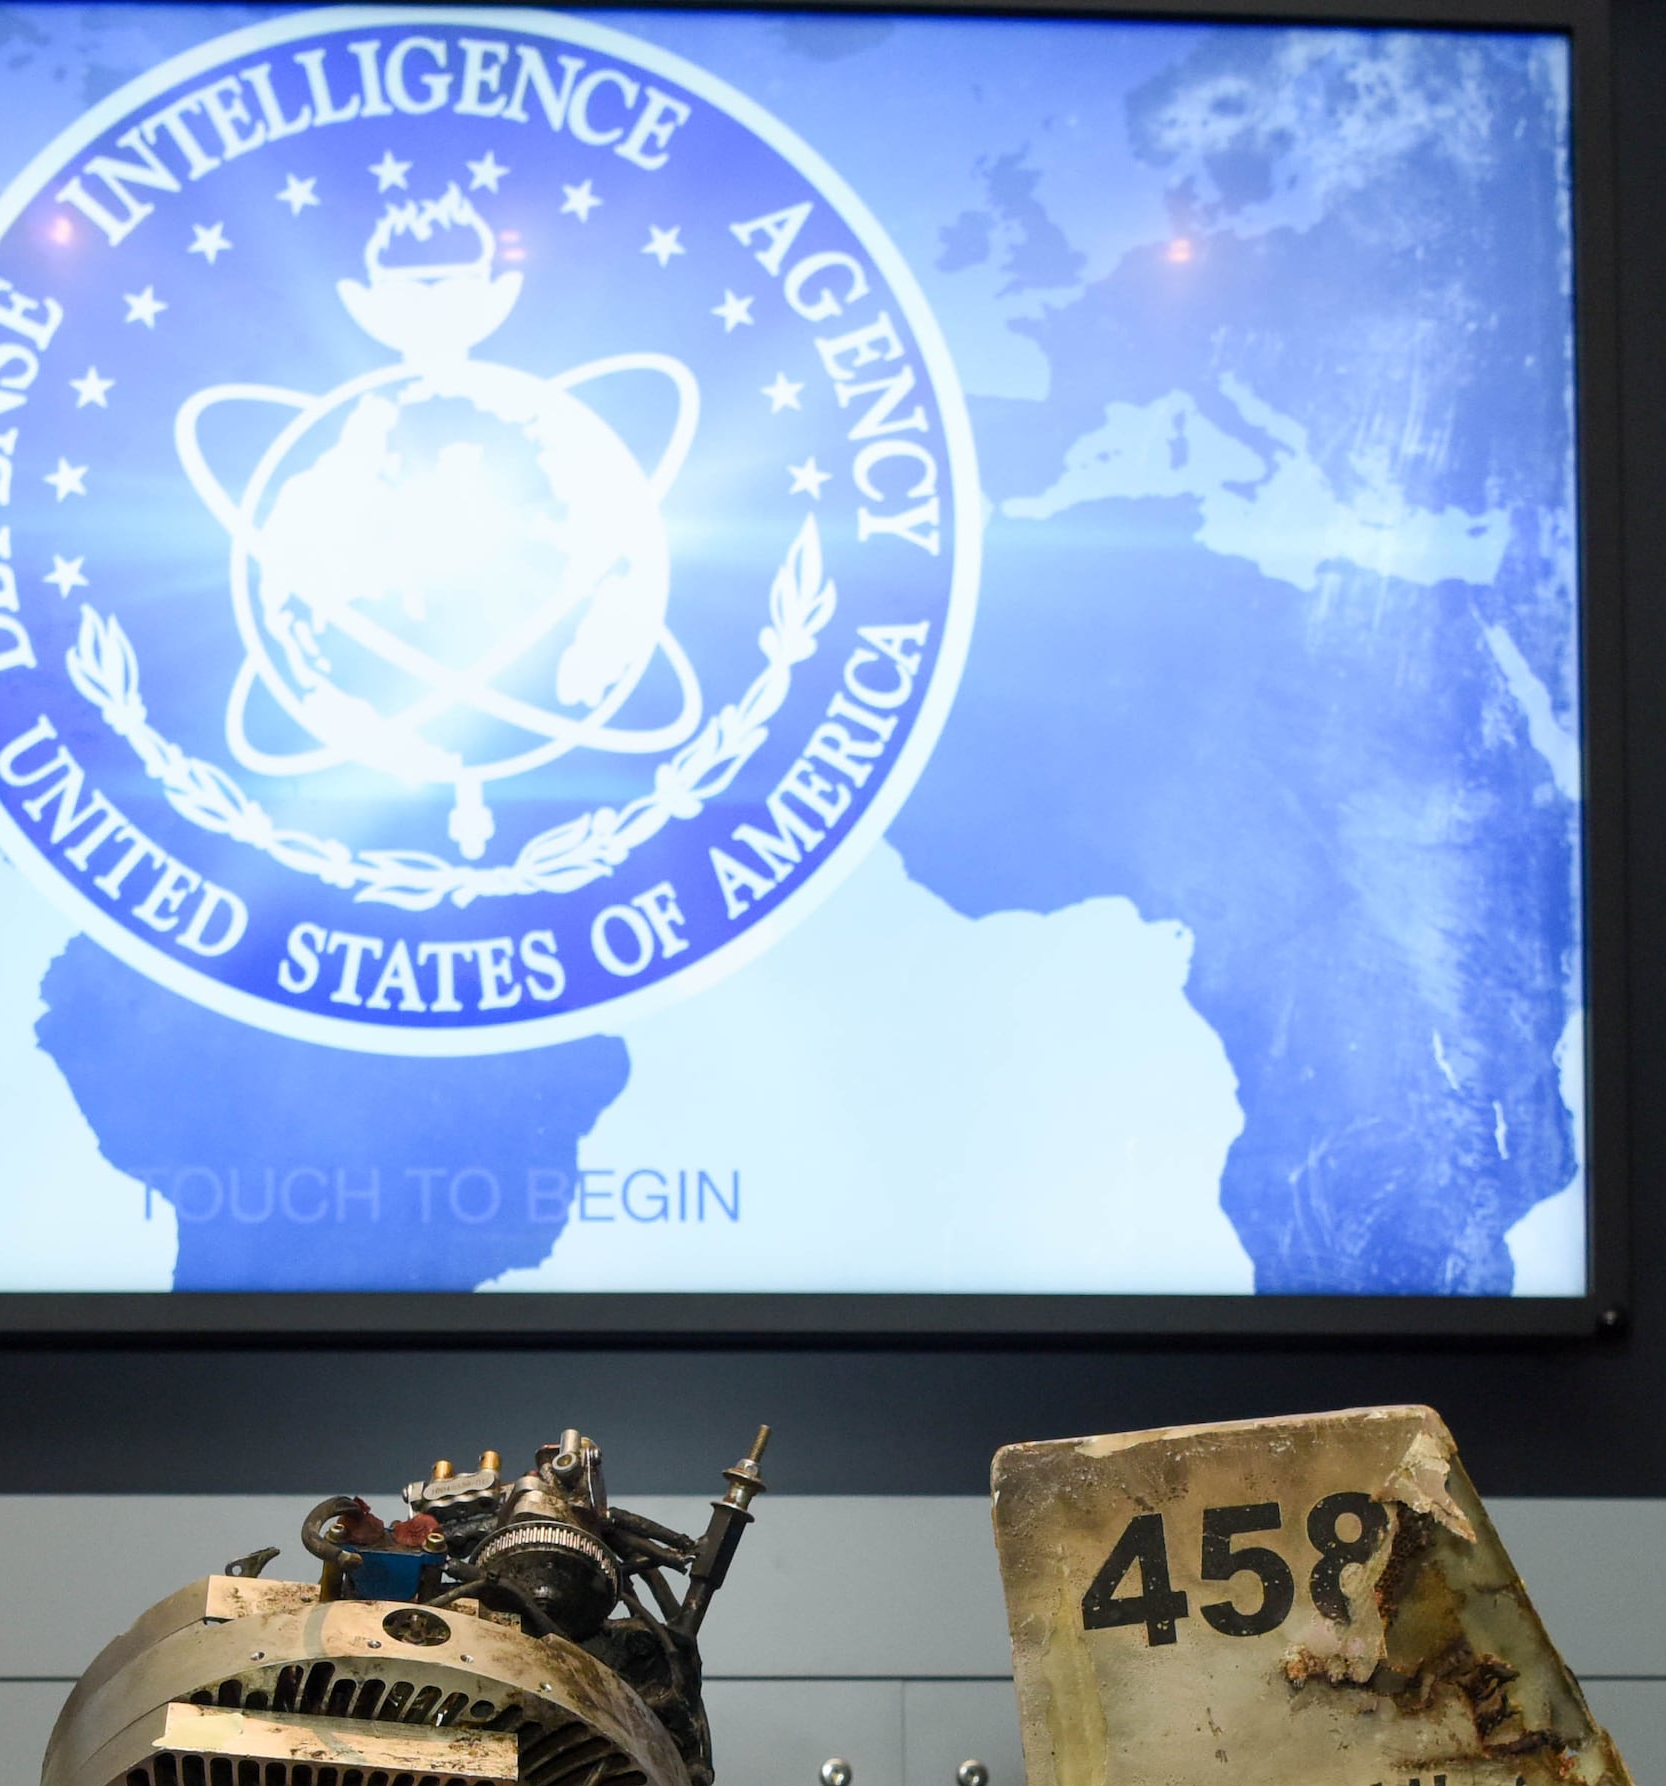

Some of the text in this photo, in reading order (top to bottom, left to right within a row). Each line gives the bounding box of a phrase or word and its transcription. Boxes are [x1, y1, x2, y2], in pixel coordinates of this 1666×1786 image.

[58, 37, 691, 248] INTELLIGENCE
[733, 200, 941, 555] AGENCY
[277, 922, 567, 1013] STATES
[590, 884, 691, 976] OF
[708, 620, 931, 919] AMERICA
[140, 1166, 740, 1223] TOUCH TO BEGIN
